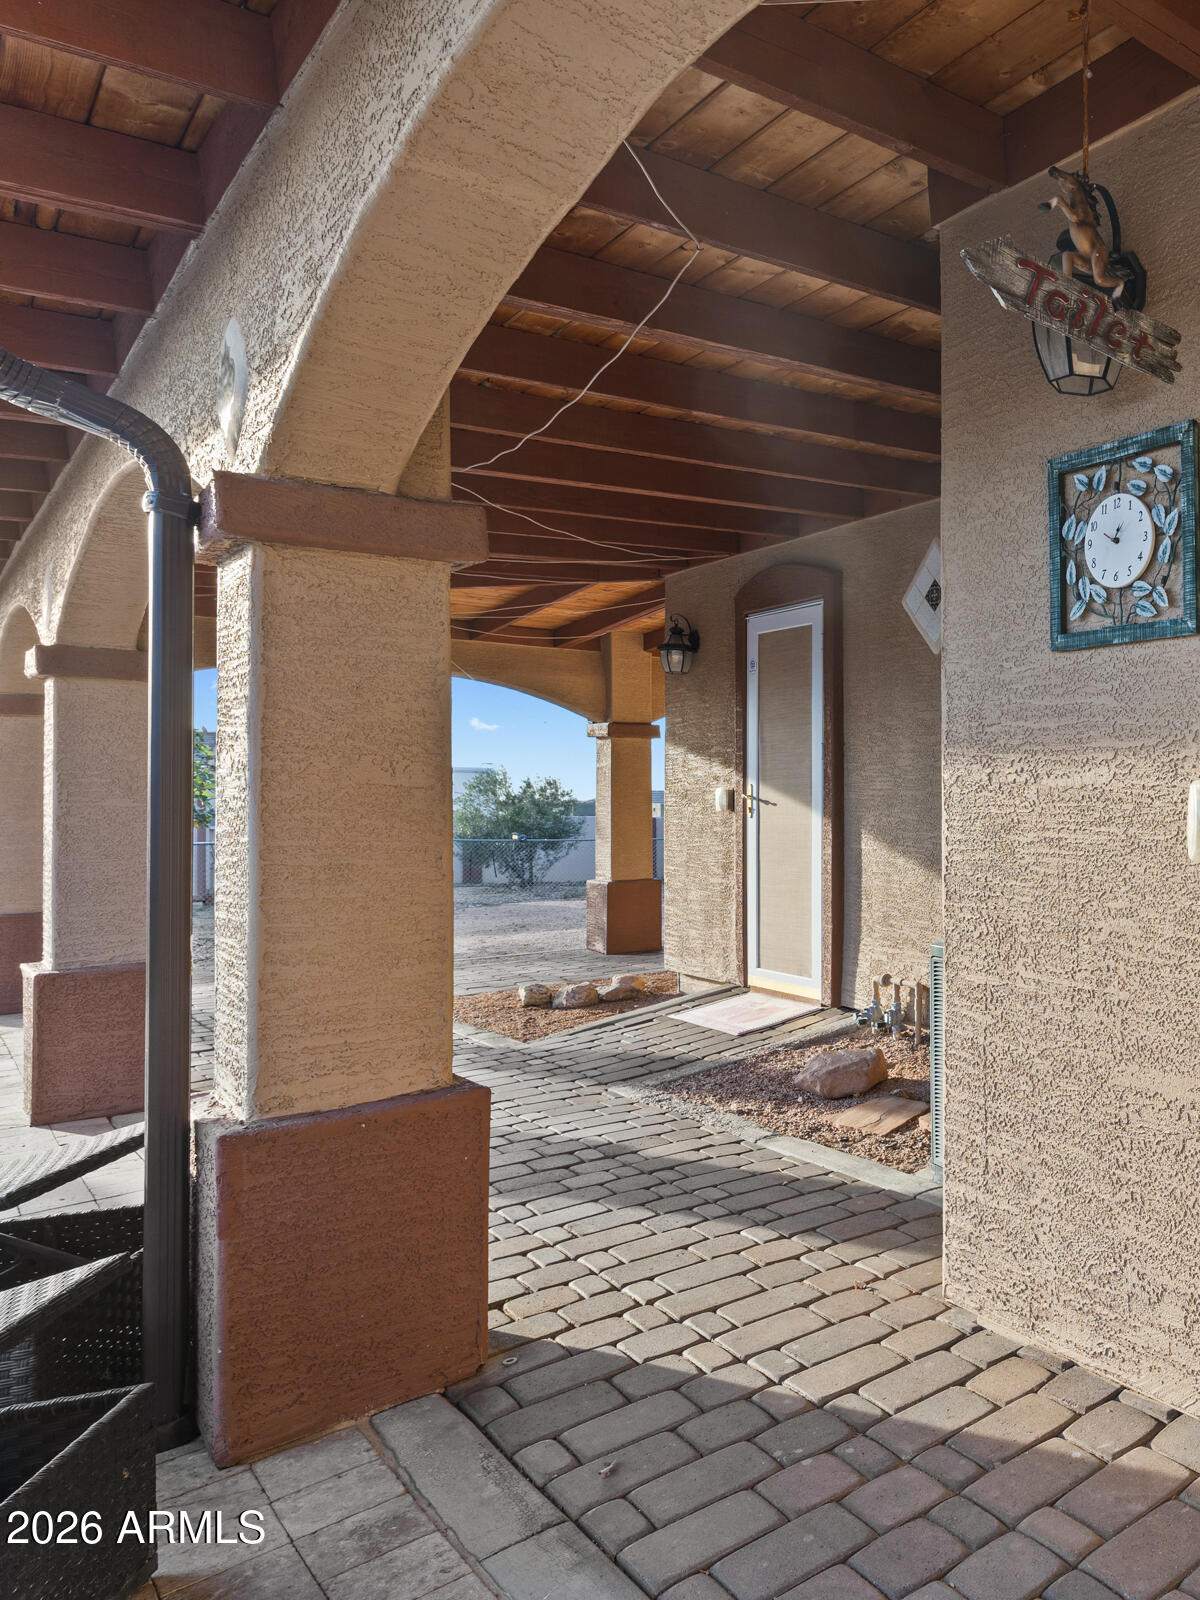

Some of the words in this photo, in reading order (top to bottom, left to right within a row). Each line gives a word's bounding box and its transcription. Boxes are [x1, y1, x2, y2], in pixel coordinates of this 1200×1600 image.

[1017, 257, 1156, 360] Toilet
[1113, 497, 1121, 509] 12
[1129, 500, 1132, 510] 1
[1102, 504, 1107, 515] 11
[1139, 511, 1143, 522] 2
[1090, 521, 1098, 532] 10
[1143, 531, 1148, 541] 3
[1088, 540, 1092, 550] 9
[1138, 552, 1143, 561] 4
[1092, 558, 1096, 568] 8
[1102, 570, 1106, 580] 7
[1127, 565, 1132, 576] 5
[1114, 571, 1119, 581] 6
